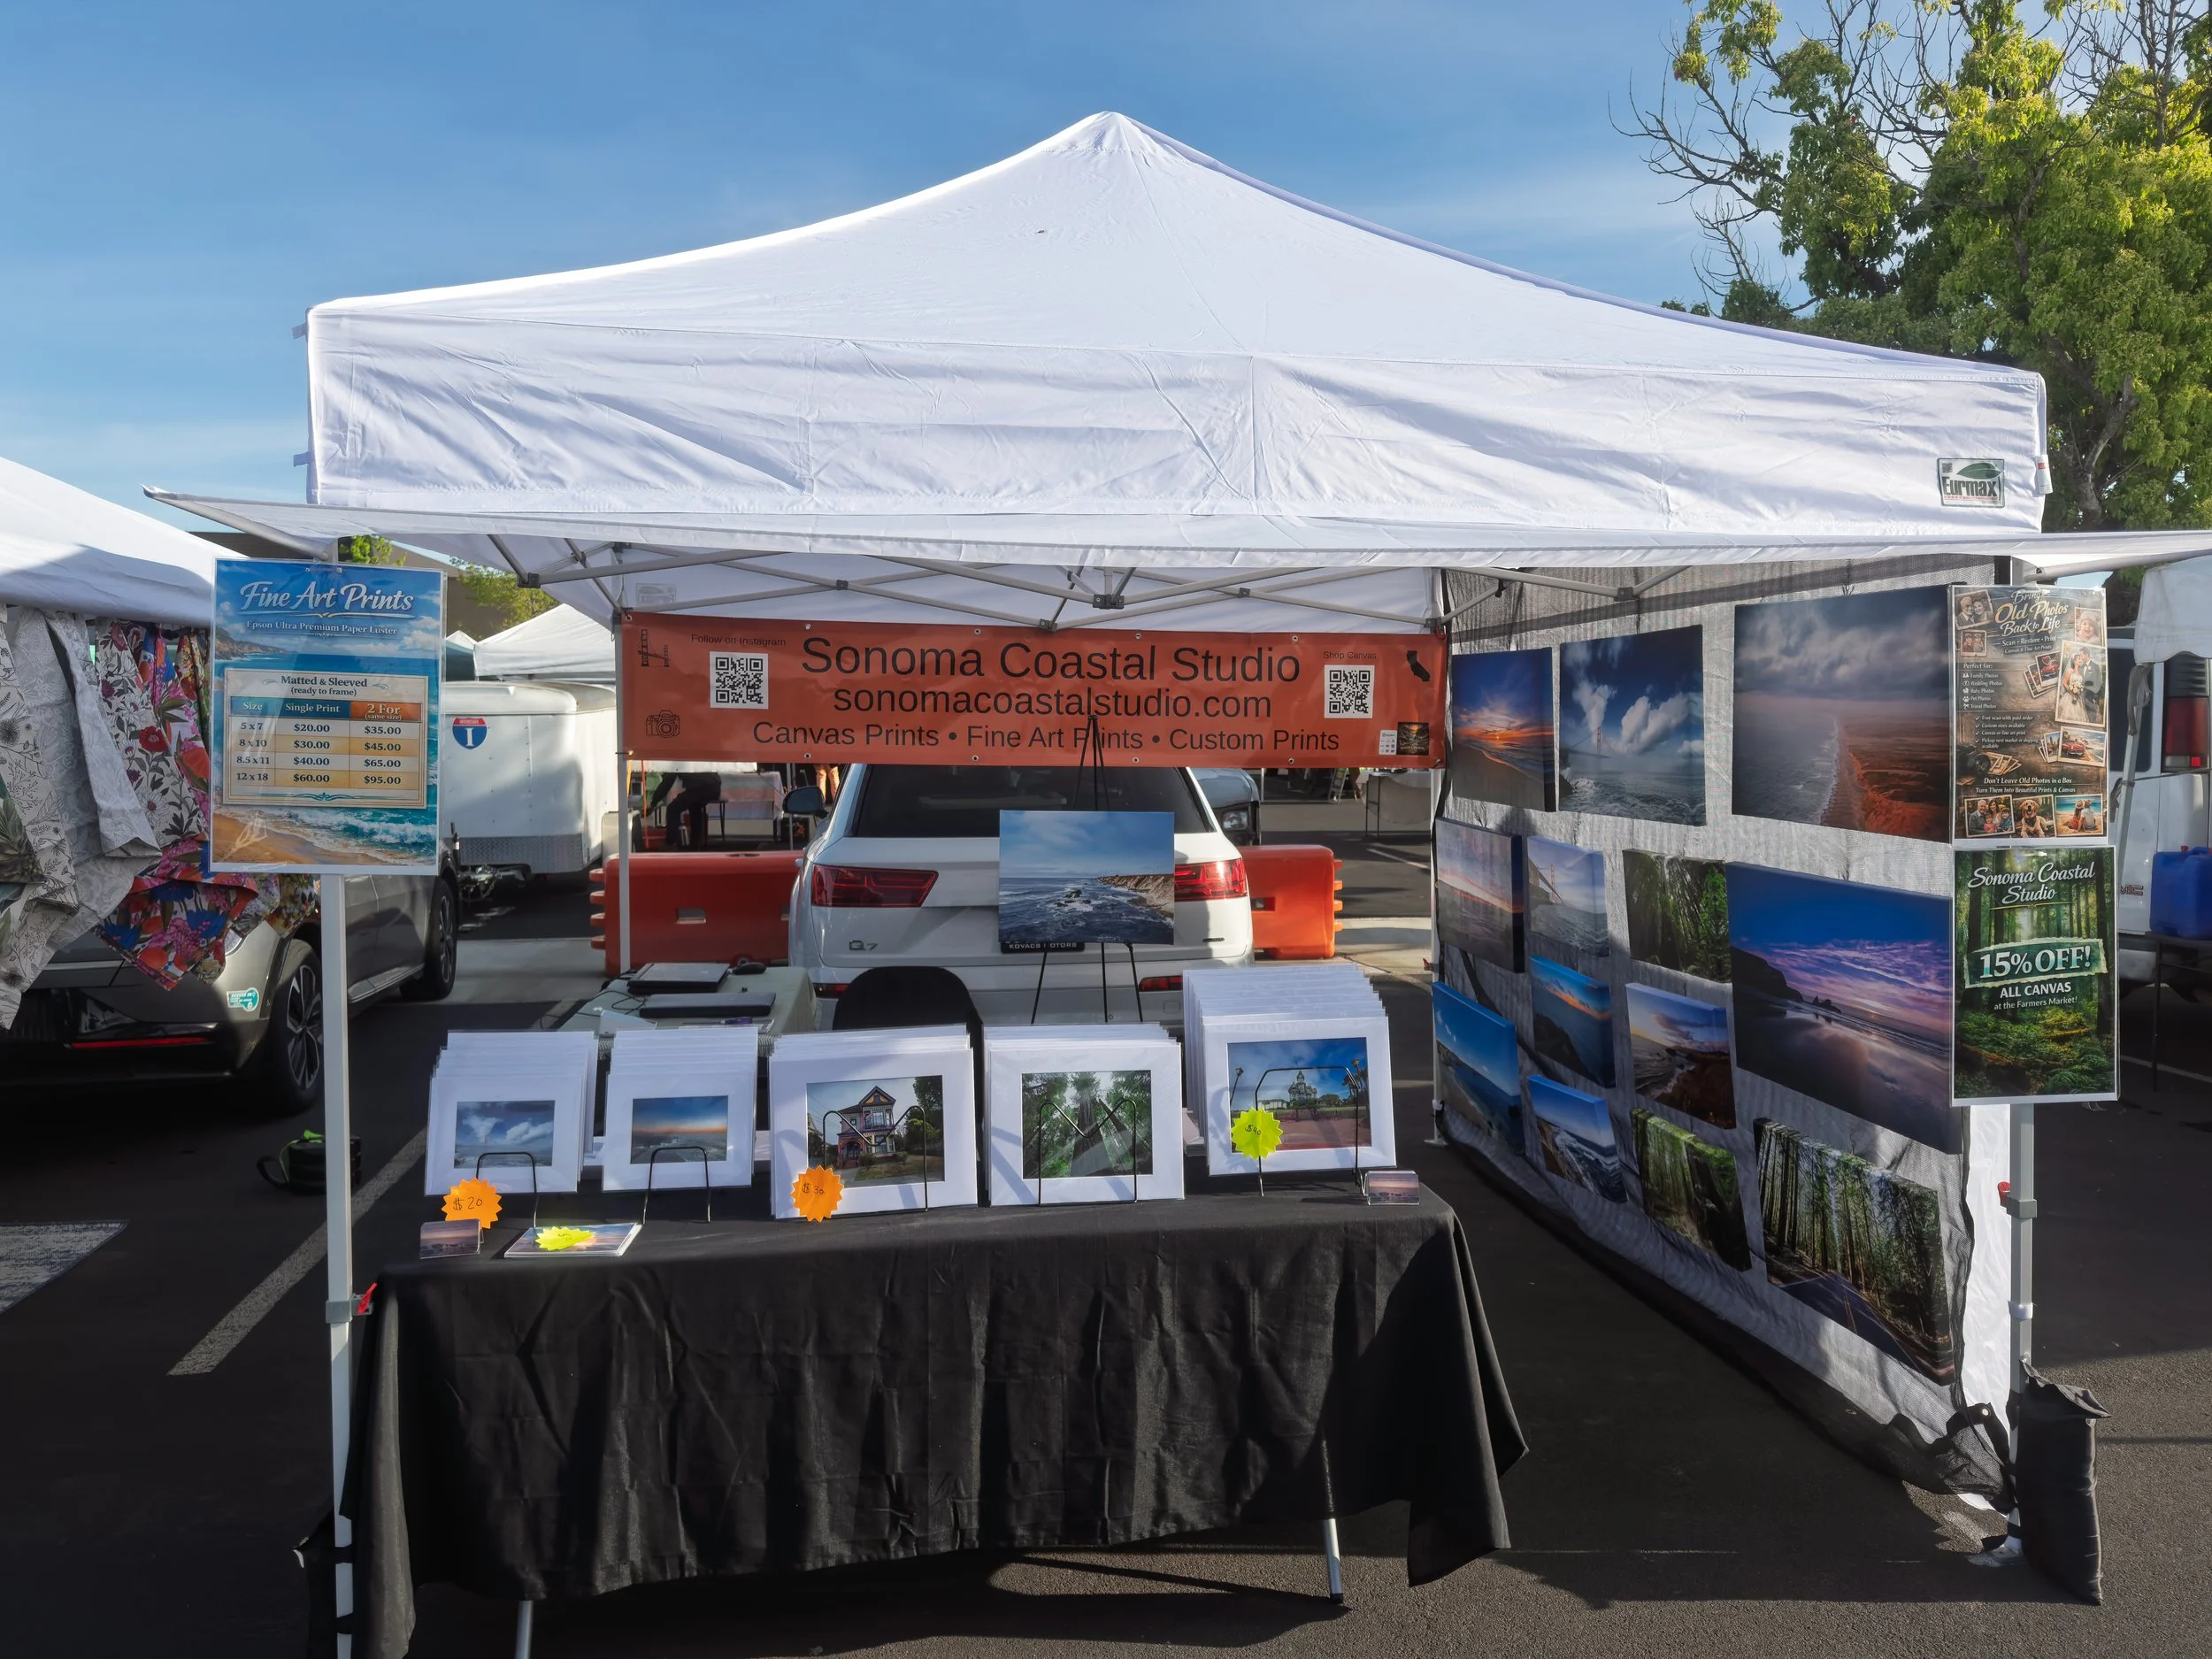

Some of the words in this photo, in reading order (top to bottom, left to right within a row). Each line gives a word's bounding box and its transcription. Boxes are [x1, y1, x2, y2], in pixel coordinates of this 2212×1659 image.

[1942, 476, 1997, 496] Eurmax
[240, 581, 290, 610] Fine
[289, 580, 338, 610] Art
[340, 583, 414, 611] Prints
[2011, 589, 2041, 604] Bring
[1995, 603, 2028, 624] Old
[2030, 601, 2069, 619] Photos
[342, 625, 367, 634] Paper
[370, 626, 397, 634] Luster
[2000, 619, 2034, 637] Back
[2037, 615, 2061, 634] Life
[691, 634, 722, 643] Follow
[740, 637, 786, 647] Instagram
[802, 637, 985, 677] Sonoma
[1000, 643, 1156, 681] Coastal
[1171, 647, 1301, 683] Studio
[1324, 651, 1345, 660] Shop
[280, 676, 318, 685] Matted
[329, 678, 367, 687] Sleeved
[291, 687, 316, 695] (ready
[328, 687, 357, 696] frame)
[242, 702, 263, 710] Size
[833, 687, 1271, 718] sonomacoastalstudio.com
[286, 703, 313, 713] Single
[317, 704, 340, 713] Print
[367, 704, 376, 713] 2
[379, 704, 401, 714] For
[294, 723, 330, 733] $20.00
[365, 726, 401, 735] $35.00
[753, 722, 856, 746] Canvas
[865, 724, 939, 747] Prints
[968, 726, 1021, 748] Fine
[1029, 726, 1064, 748] Art
[1169, 729, 1264, 750] Custom
[1273, 730, 1340, 750] Prints
[294, 741, 330, 749] $30.00
[365, 742, 401, 751] $45.00
[294, 757, 330, 766] $40.00
[364, 759, 401, 768] $65.00
[294, 774, 330, 783] $60.00
[364, 776, 401, 785] $95.00
[1968, 867, 2035, 888] Sonoma
[2038, 861, 2095, 882] Coastal
[2002, 884, 2058, 904] Studio
[849, 940, 878, 951] Q7
[1980, 951, 2032, 979] 15%
[2035, 945, 2091, 972] OFF!
[2000, 987, 2021, 999] ALL
[2024, 981, 2071, 995] CANVAS
[2048, 996, 2078, 1005] Market!
